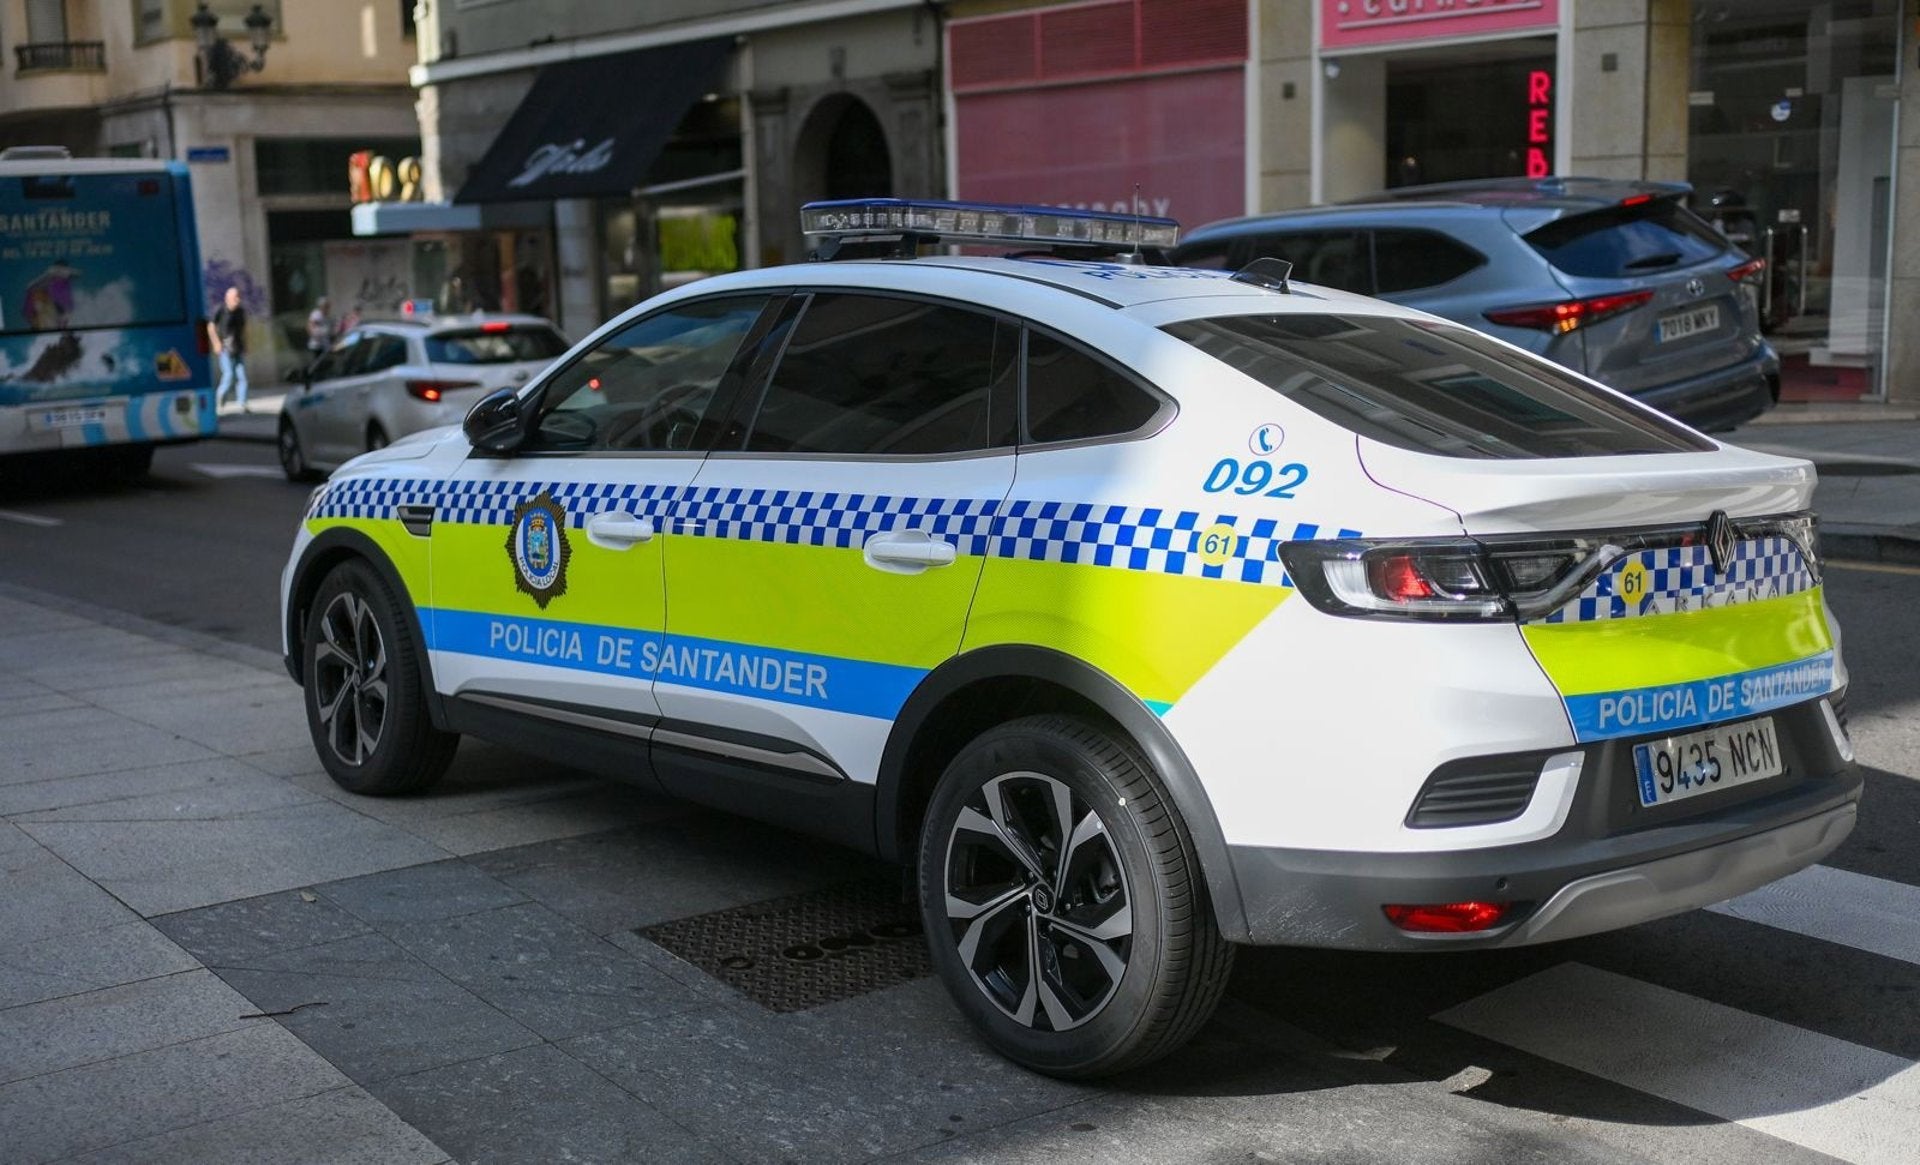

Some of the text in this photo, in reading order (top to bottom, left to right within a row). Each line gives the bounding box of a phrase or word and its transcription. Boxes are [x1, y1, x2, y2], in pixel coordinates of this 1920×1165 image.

[1202, 457, 1309, 499] 092
[1204, 533, 1231, 555] 61
[1624, 571, 1642, 595] 61
[1641, 584, 1778, 616] ARKANA
[490, 621, 828, 699] POLICIA DE SANTANDER
[1599, 662, 1827, 728] POLICIA DE SANTANDER
[1656, 727, 1776, 794] 9435 NCN
